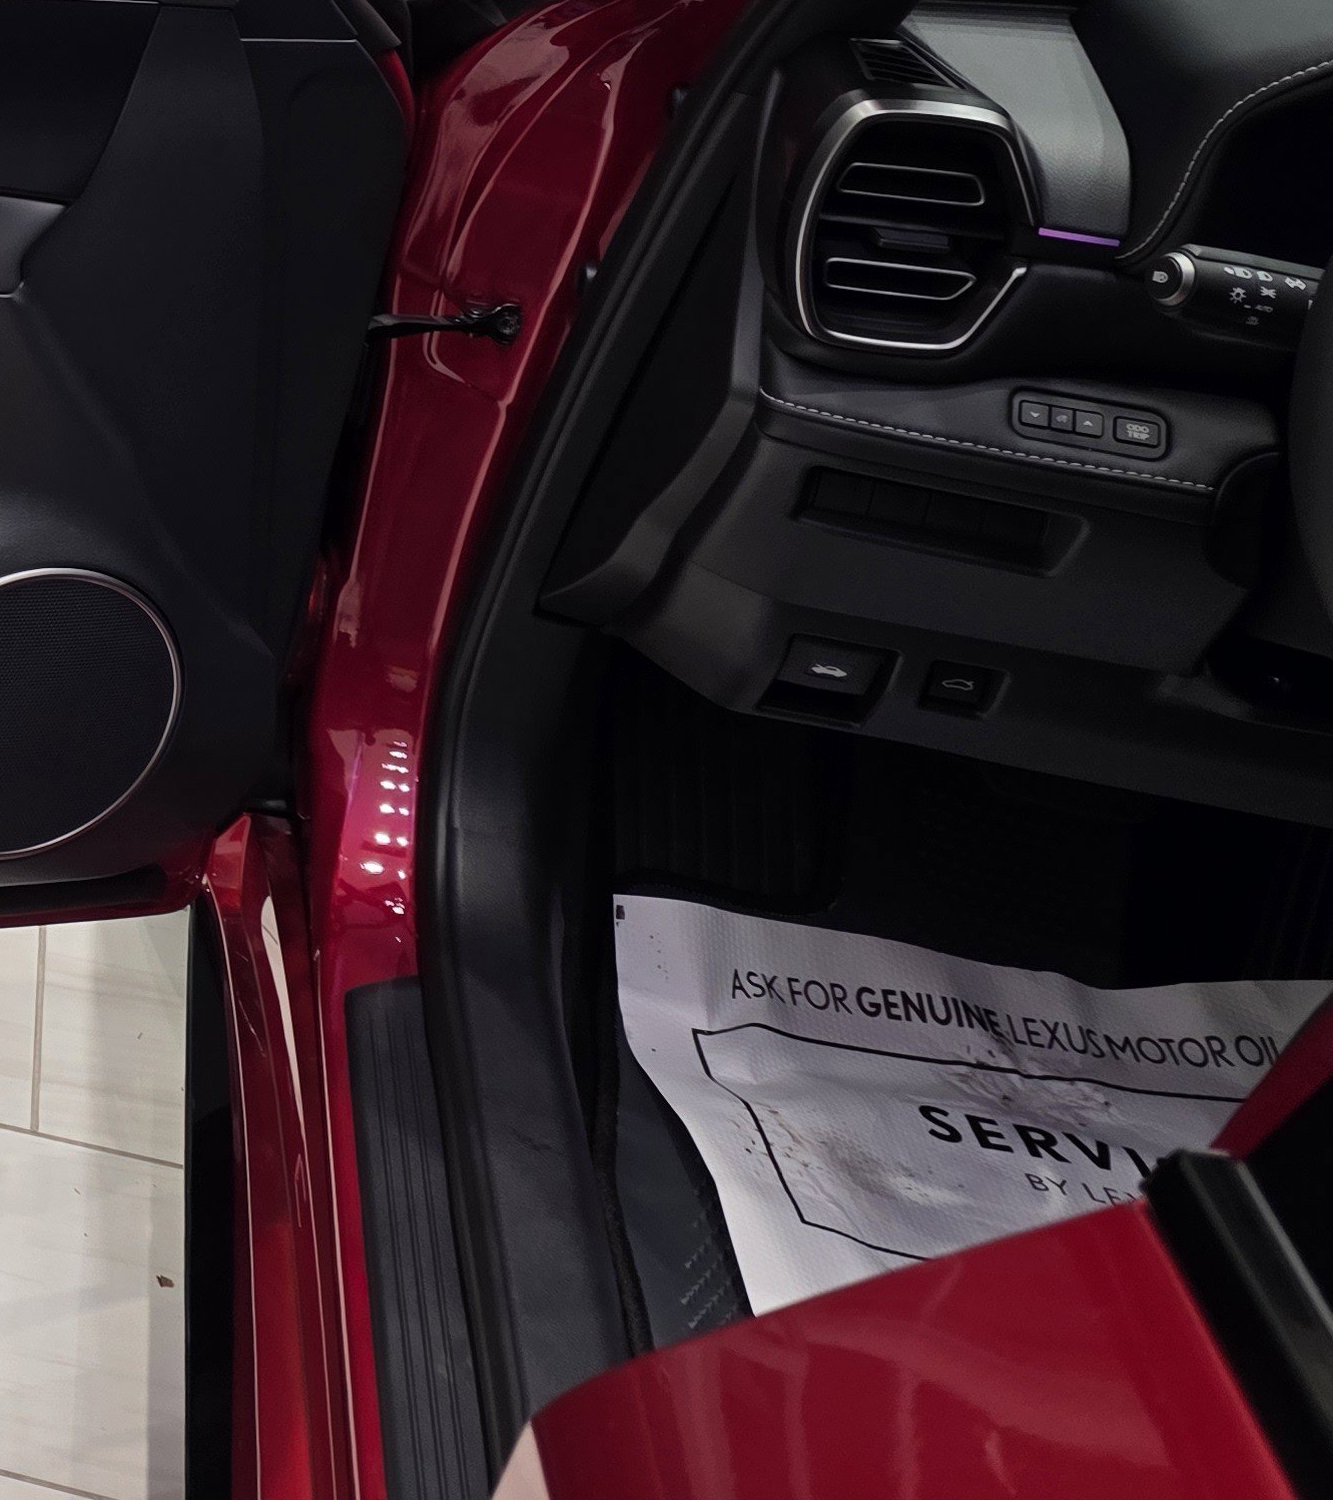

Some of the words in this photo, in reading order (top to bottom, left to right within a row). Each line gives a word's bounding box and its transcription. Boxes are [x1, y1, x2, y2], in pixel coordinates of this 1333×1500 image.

[1126, 423, 1150, 434] ODO
[732, 969, 786, 1004] ASK
[787, 977, 853, 1014] FOR
[856, 986, 1002, 1038] GENUINE
[1005, 1013, 1104, 1059] LEXUS
[1103, 1033, 1235, 1068] MOTOR
[1024, 1172, 1068, 1196] BY
